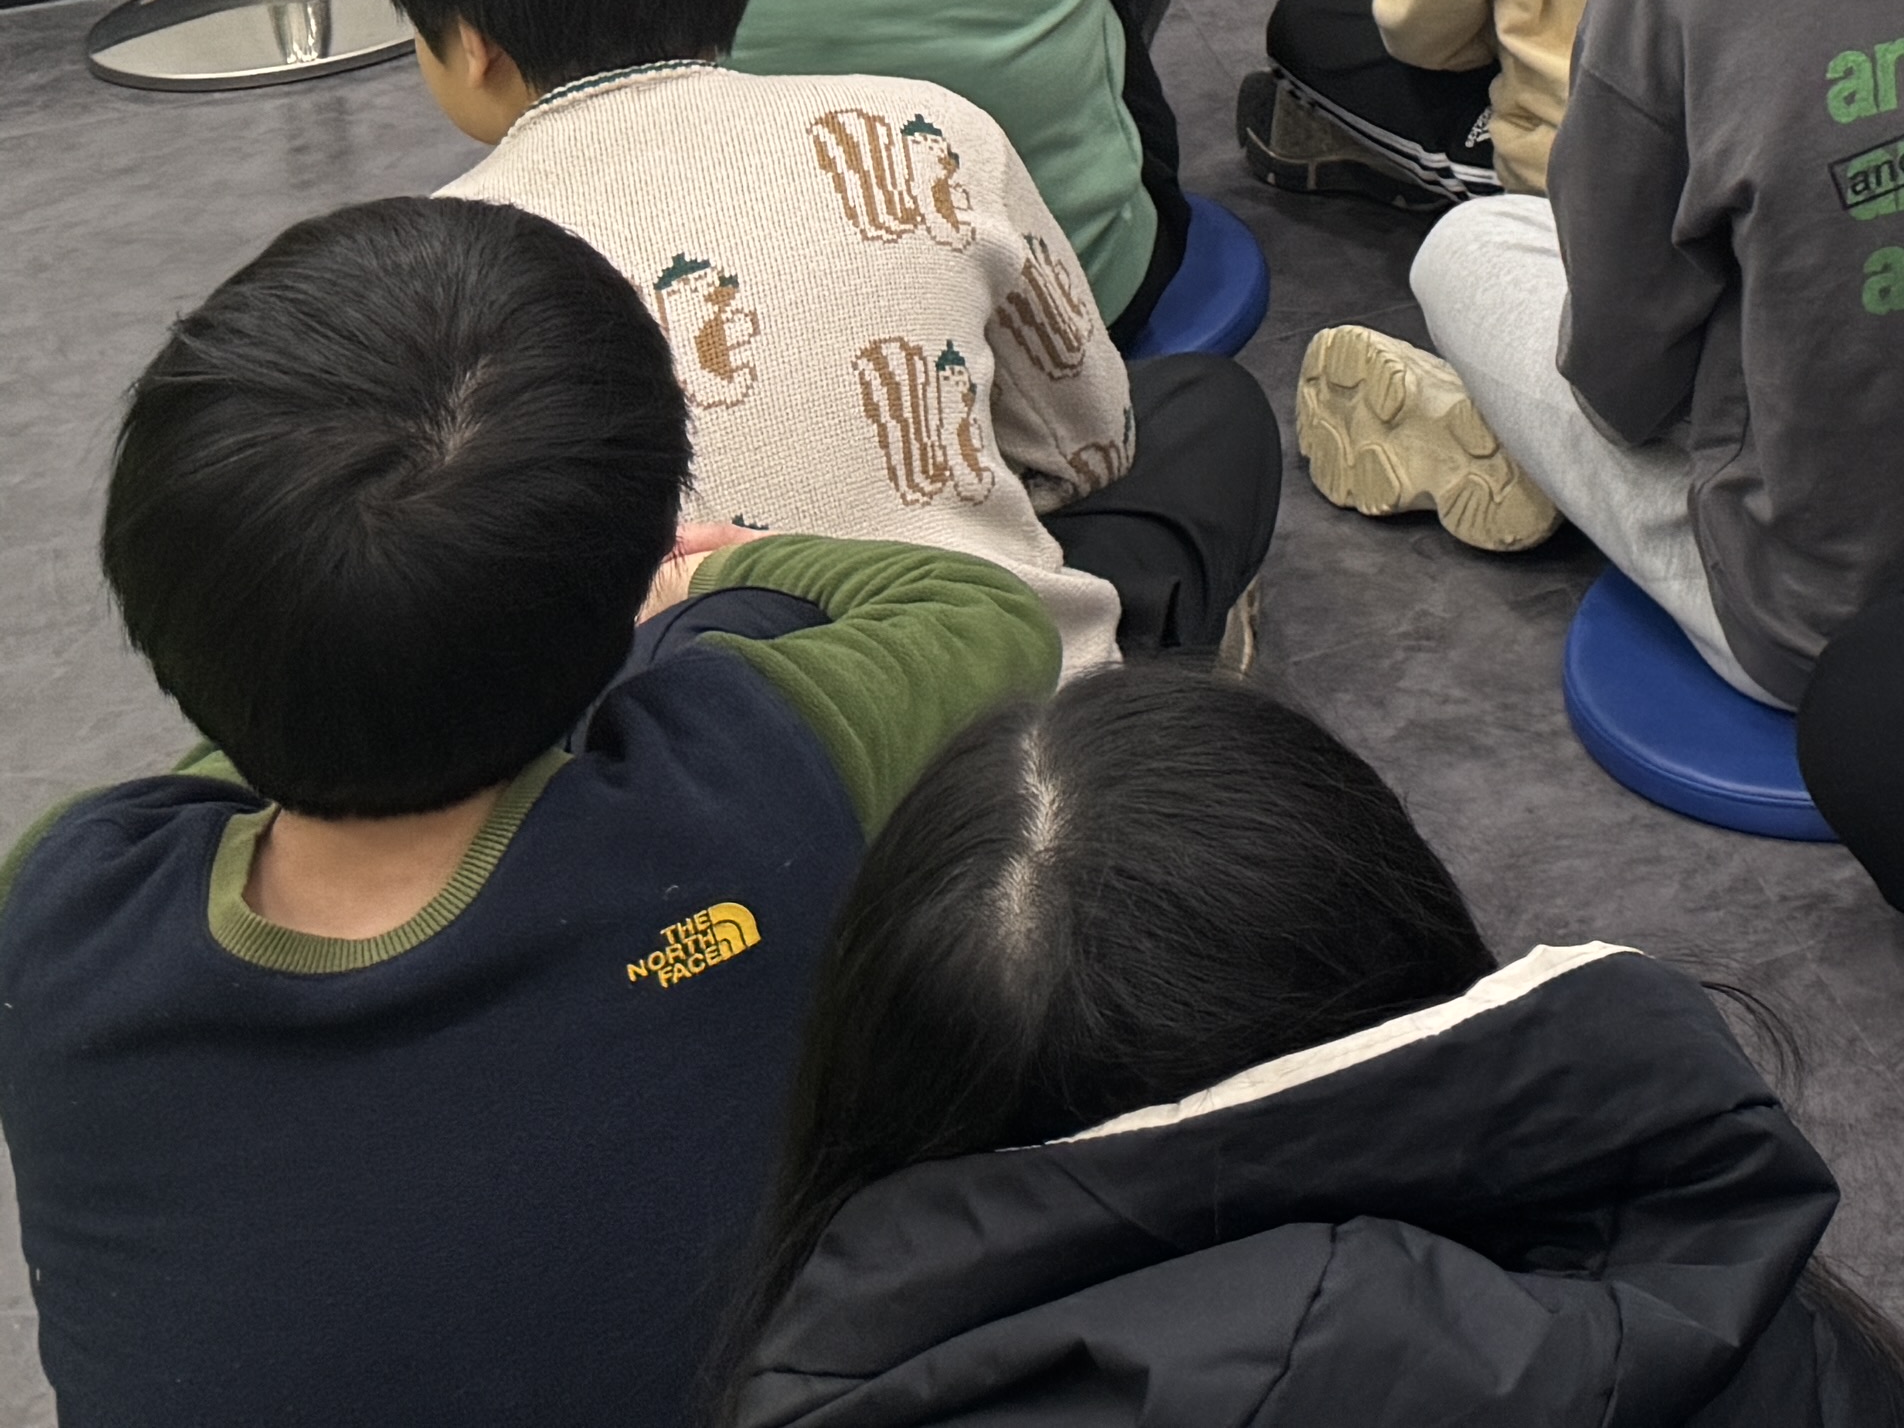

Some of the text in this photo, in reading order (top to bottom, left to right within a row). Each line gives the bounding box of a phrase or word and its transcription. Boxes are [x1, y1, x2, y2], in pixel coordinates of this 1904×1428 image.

[660, 909, 712, 945] THE
[626, 928, 717, 983] NORTH
[657, 945, 723, 989] FACE
